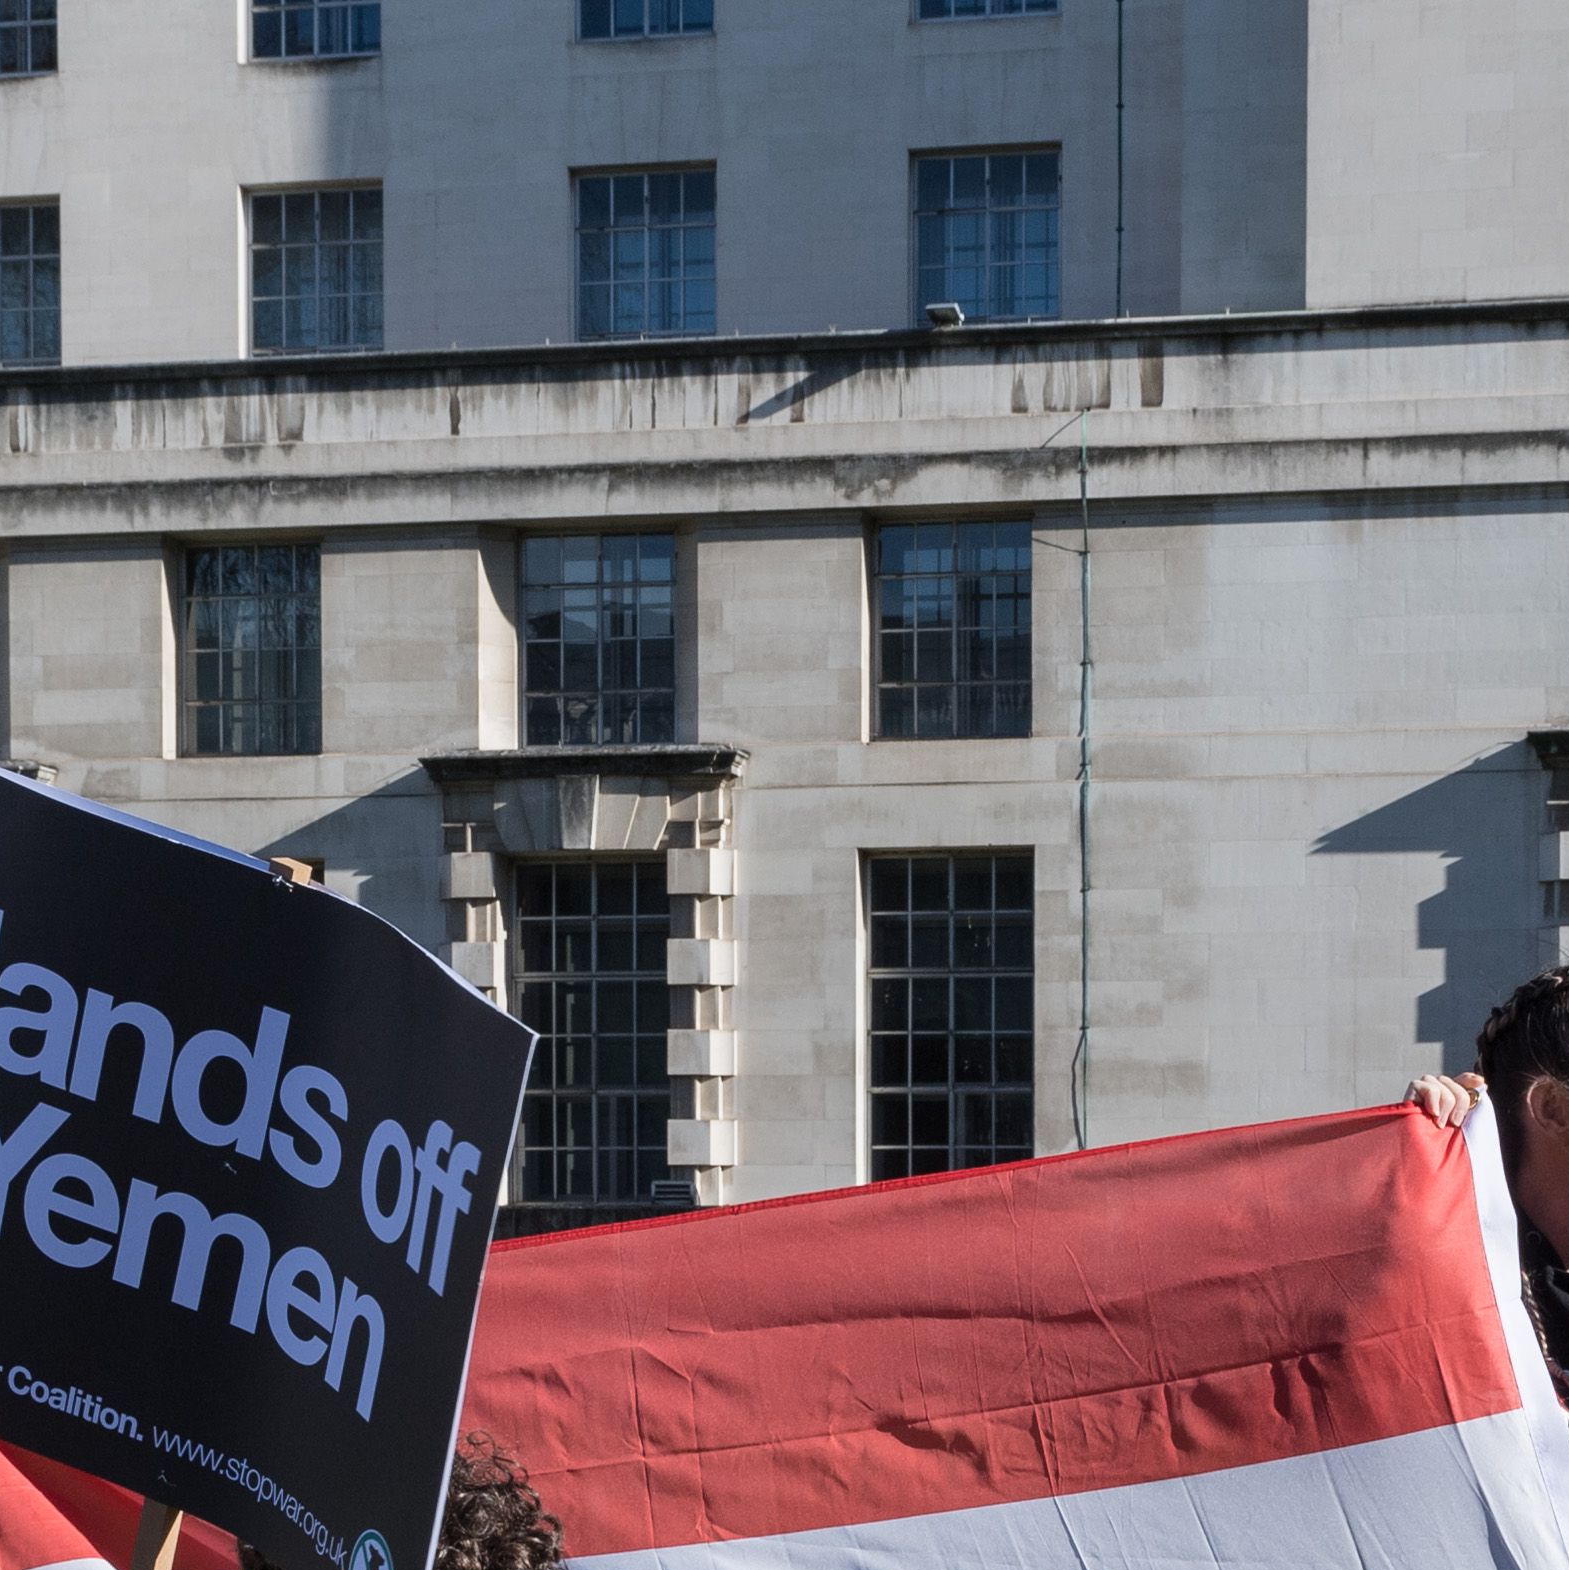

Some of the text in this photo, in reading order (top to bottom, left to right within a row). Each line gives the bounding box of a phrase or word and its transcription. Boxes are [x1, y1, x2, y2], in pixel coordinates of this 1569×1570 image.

[361, 1120, 482, 1296] off
[8, 1365, 143, 1441] Coalition.
[153, 1426, 348, 1570] www.stopwar.org.uk
